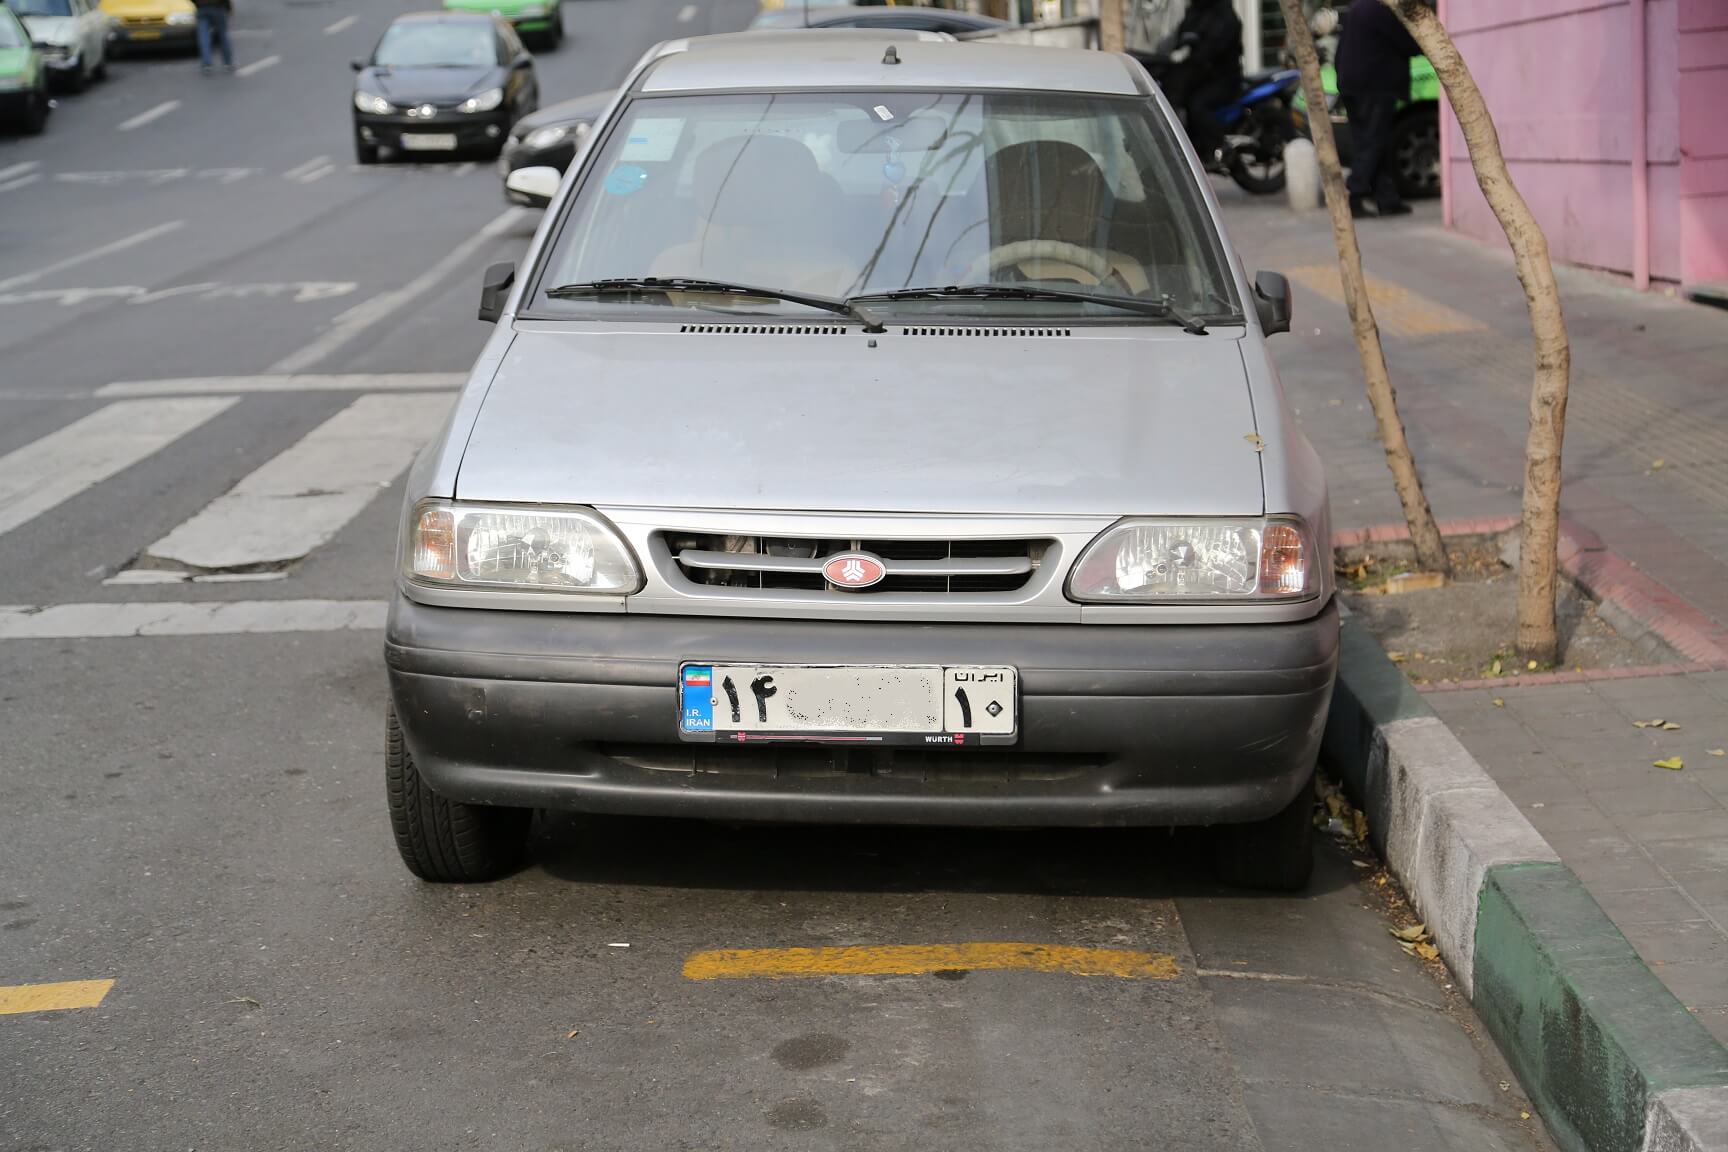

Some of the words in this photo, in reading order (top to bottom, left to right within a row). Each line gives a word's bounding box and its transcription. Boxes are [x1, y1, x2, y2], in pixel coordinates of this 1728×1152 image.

[954, 672, 1004, 683] ایران
[686, 708, 702, 717] I.R.
[686, 718, 711, 727] IRAN
